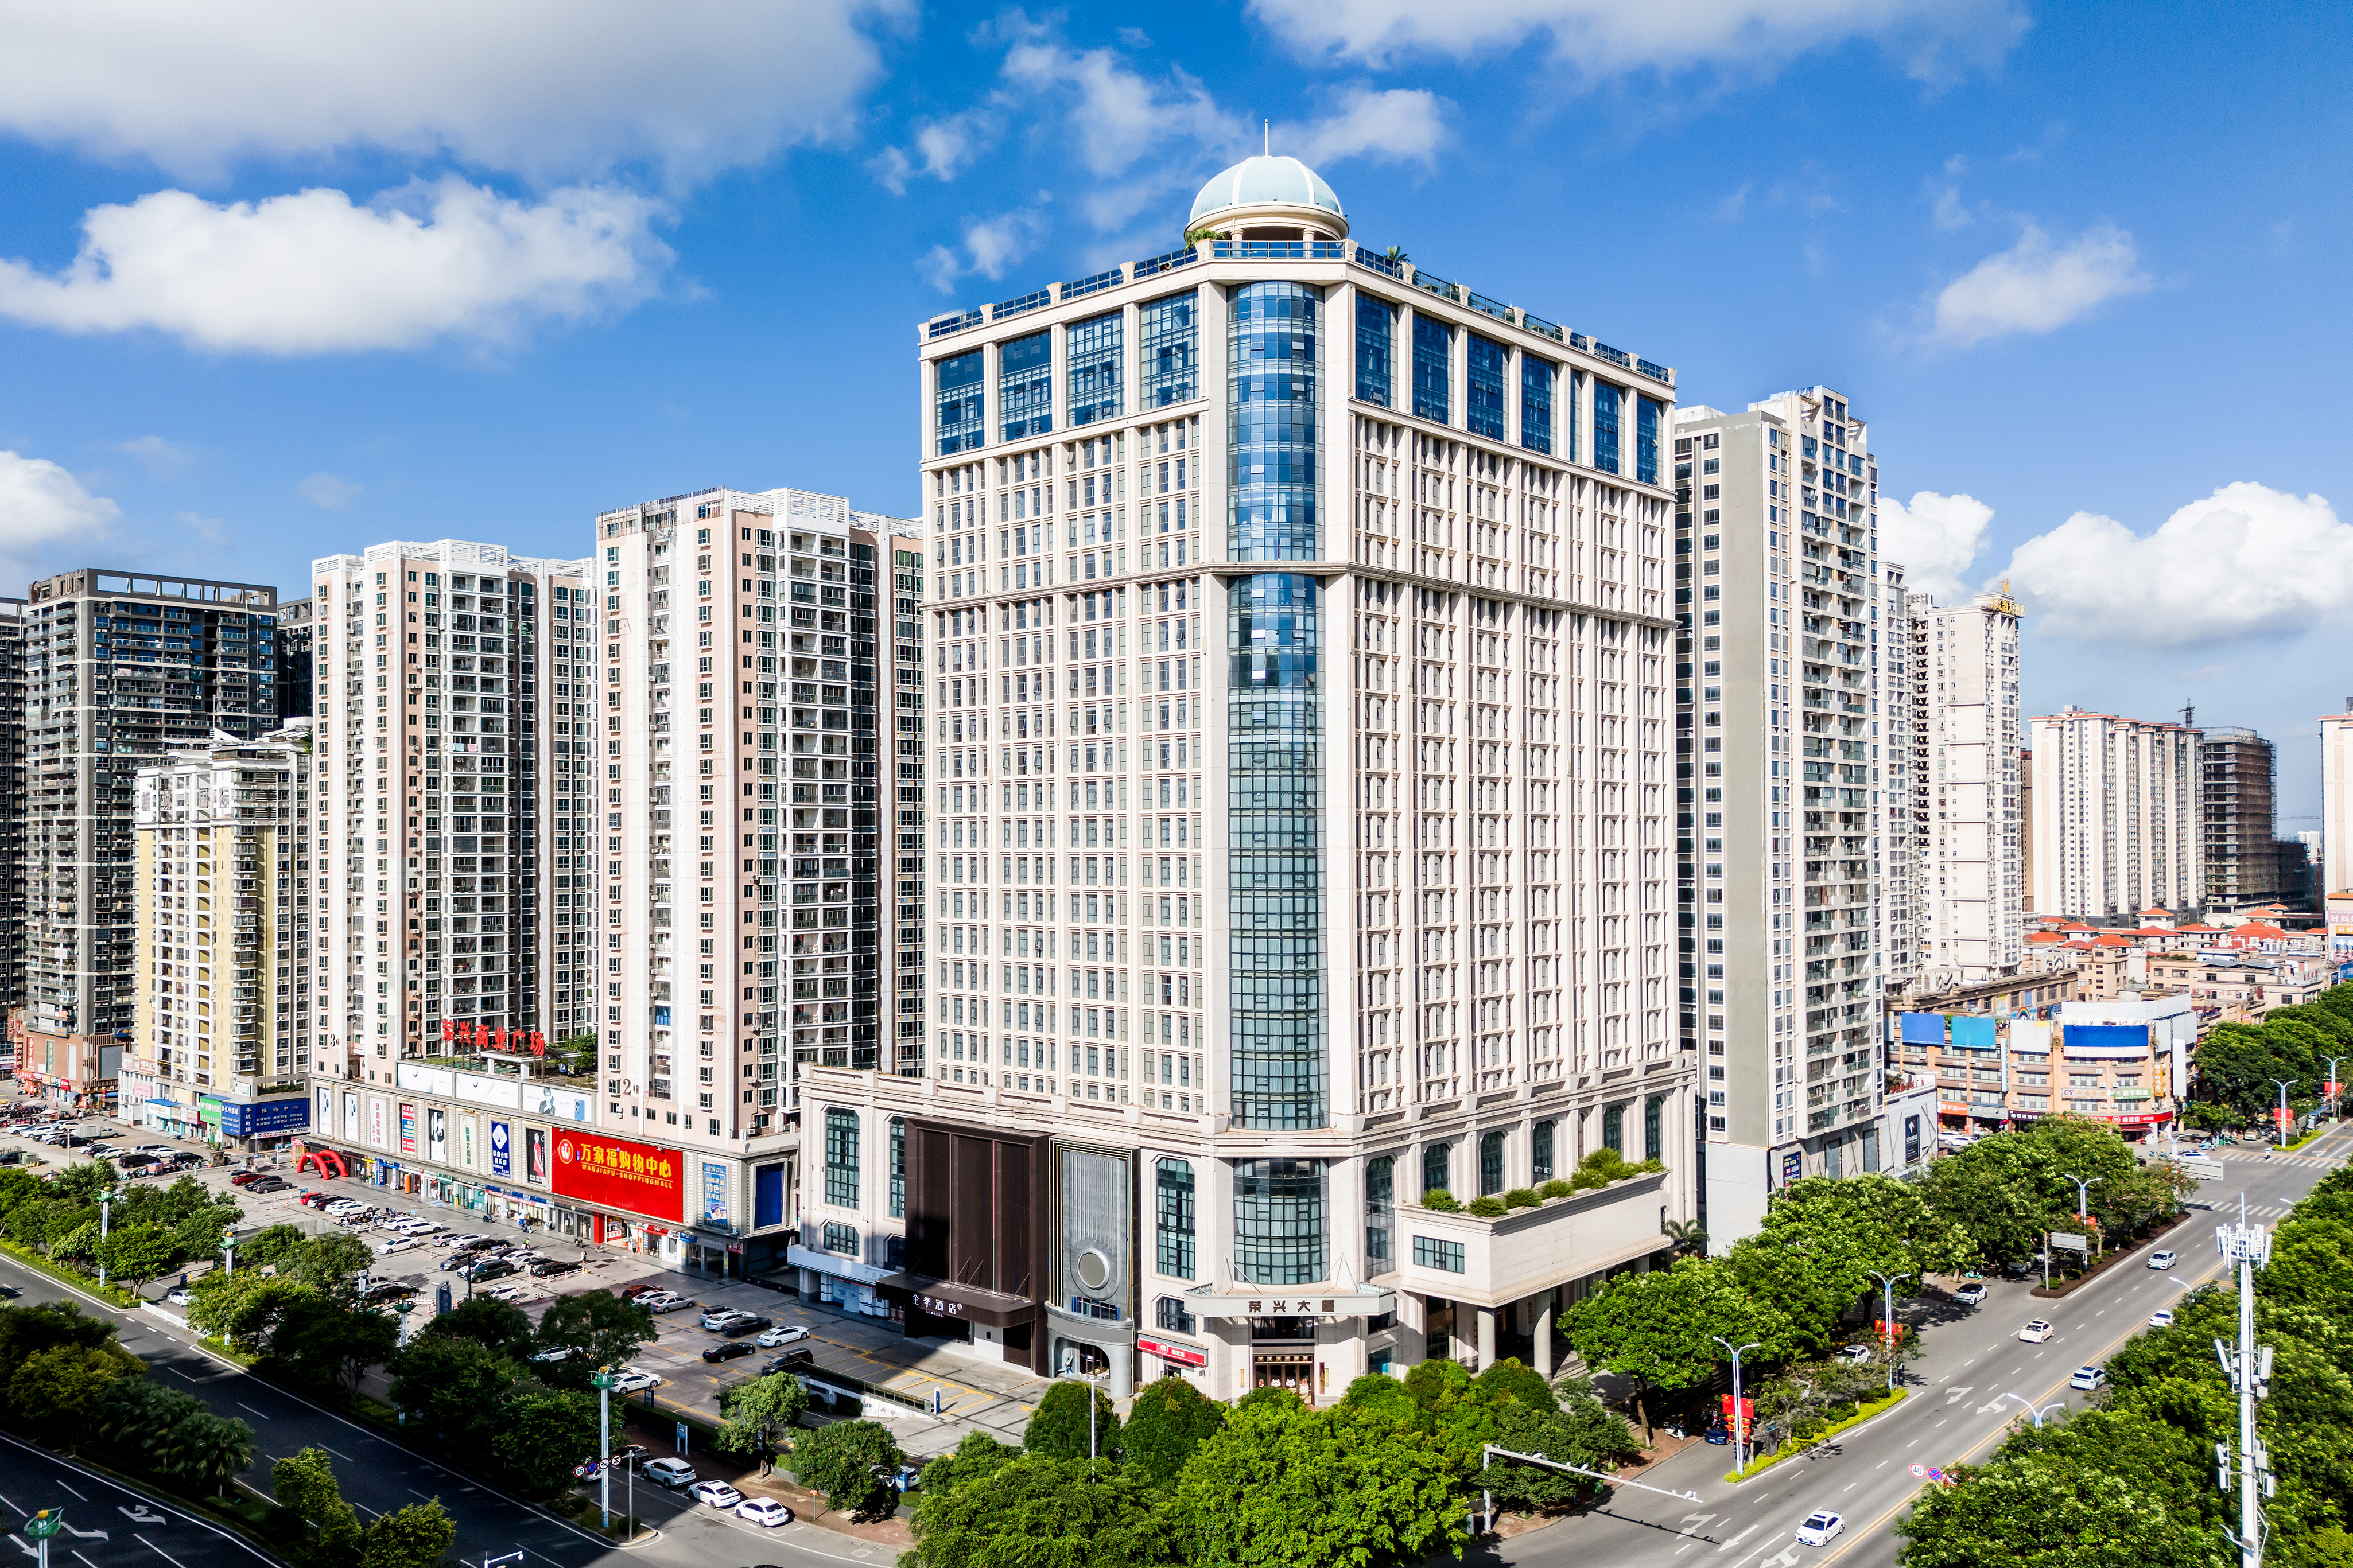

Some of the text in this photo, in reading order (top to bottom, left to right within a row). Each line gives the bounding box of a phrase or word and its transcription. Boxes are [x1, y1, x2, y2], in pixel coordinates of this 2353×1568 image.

[442, 1018, 545, 1056] 荣兴商业广场
[580, 1143, 671, 1178] 万家福购物中心
[912, 1294, 956, 1314] 全季酒店
[1913, 1466, 1921, 1474] 40
